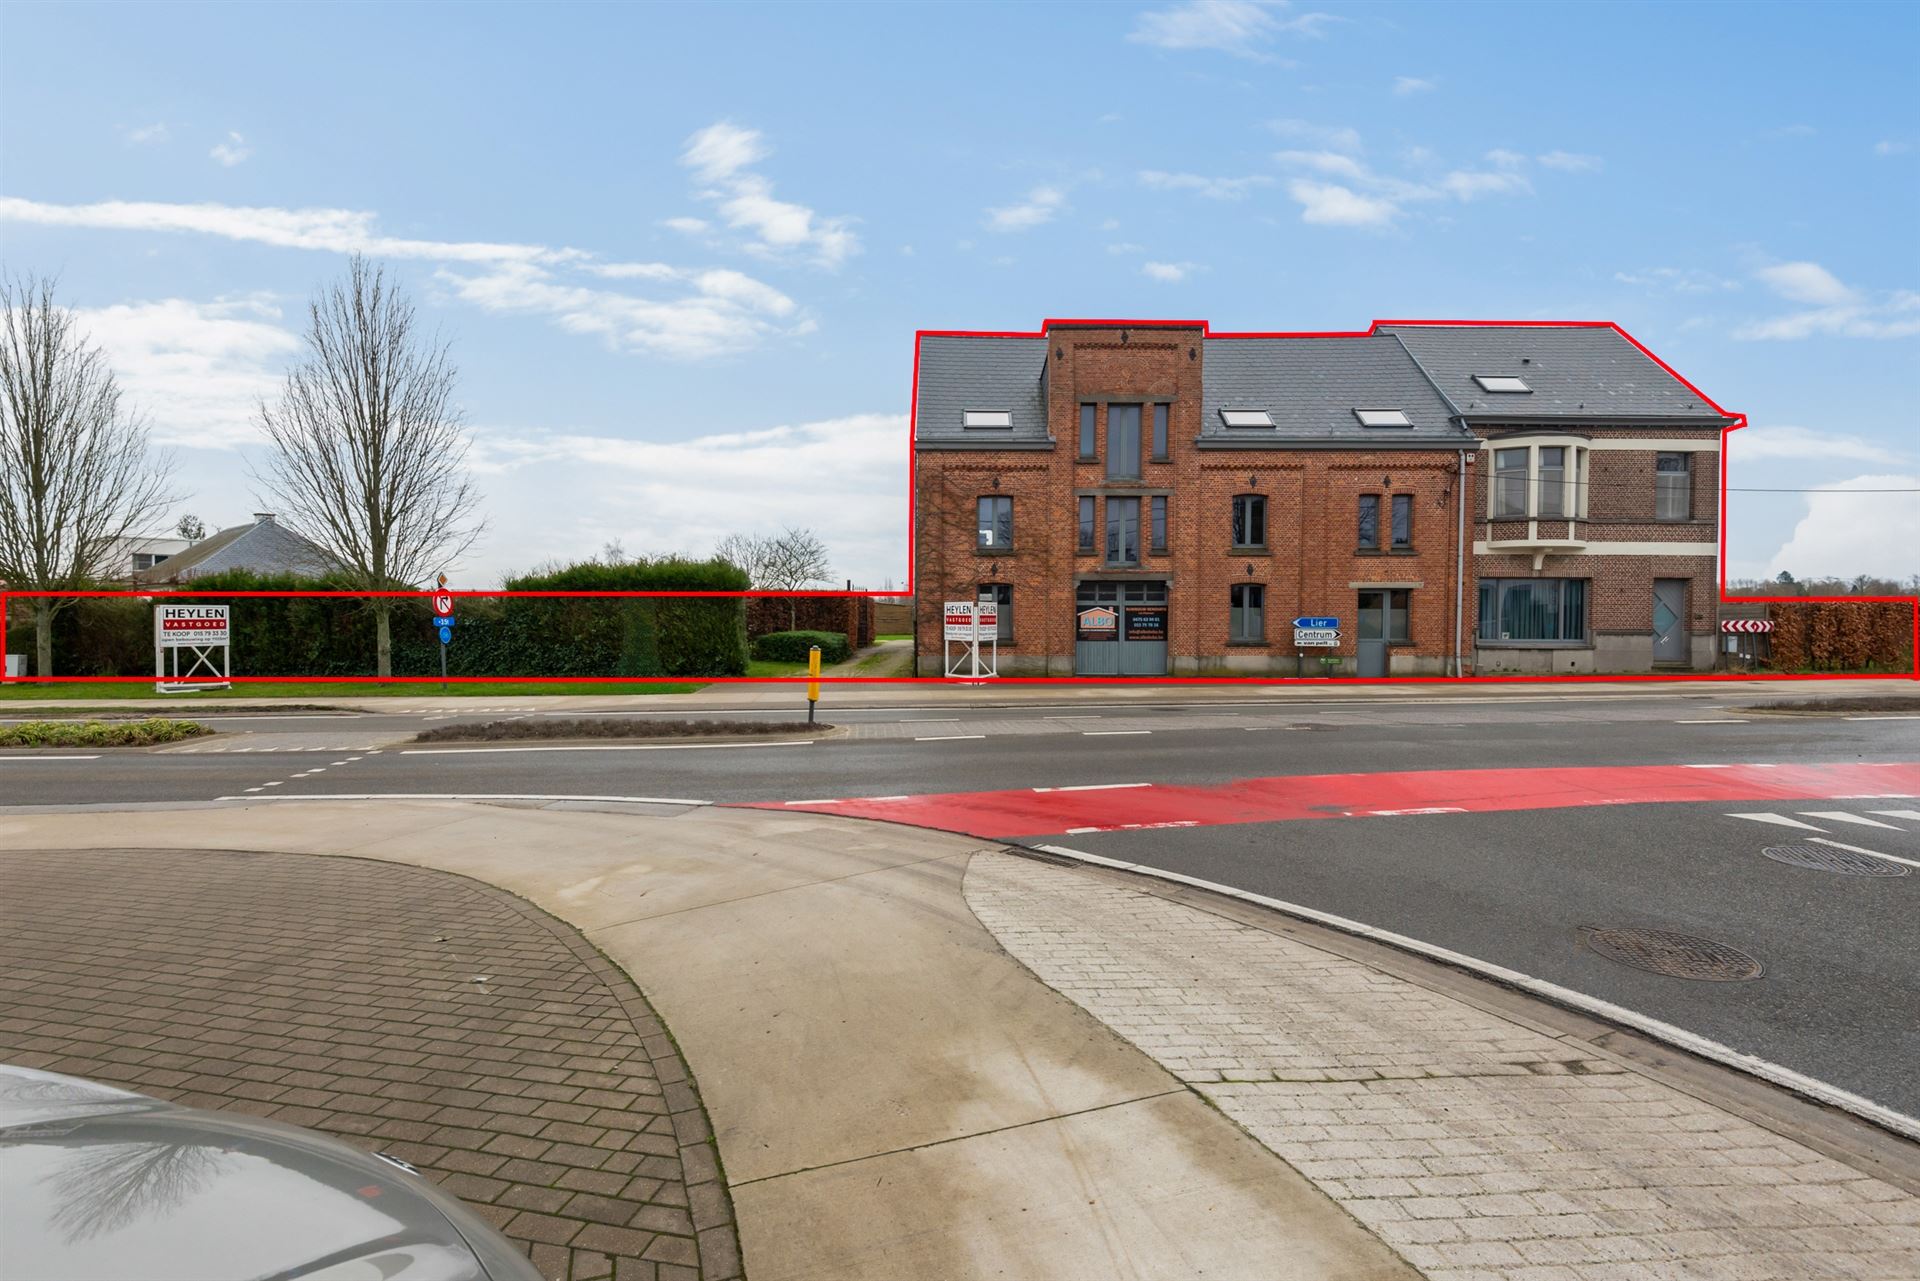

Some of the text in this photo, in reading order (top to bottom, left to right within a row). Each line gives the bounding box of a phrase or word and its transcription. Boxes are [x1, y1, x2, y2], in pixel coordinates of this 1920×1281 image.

[165, 609, 224, 618] HEYLEN
[947, 606, 971, 614] HEYLEN
[980, 606, 996, 614] HEYLEN
[1083, 616, 1114, 626] ALBO
